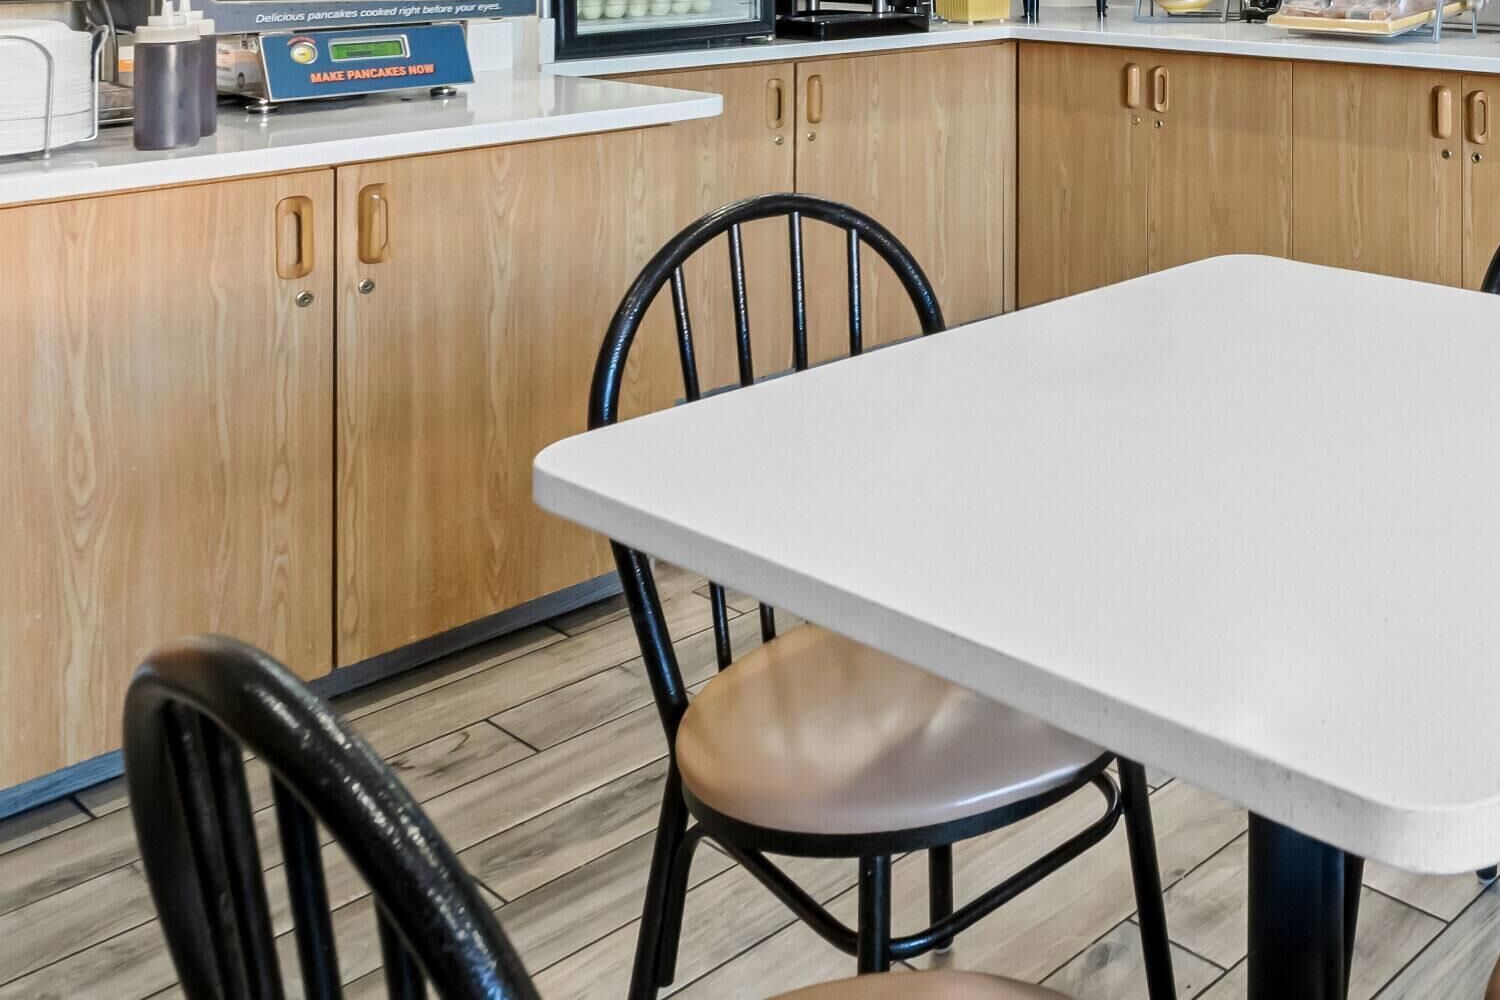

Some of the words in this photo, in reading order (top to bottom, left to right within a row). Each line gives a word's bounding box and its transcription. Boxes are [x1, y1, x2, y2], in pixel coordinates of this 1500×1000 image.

[255, 12, 305, 23] Delicious
[307, 10, 358, 21] pancakes
[360, 7, 398, 17] cooked
[398, 6, 421, 17] right
[422, 5, 453, 14] before
[454, 4, 476, 14] your
[310, 70, 345, 83] MAKE
[346, 66, 407, 80] PANCAKES
[408, 63, 435, 75] NOW
